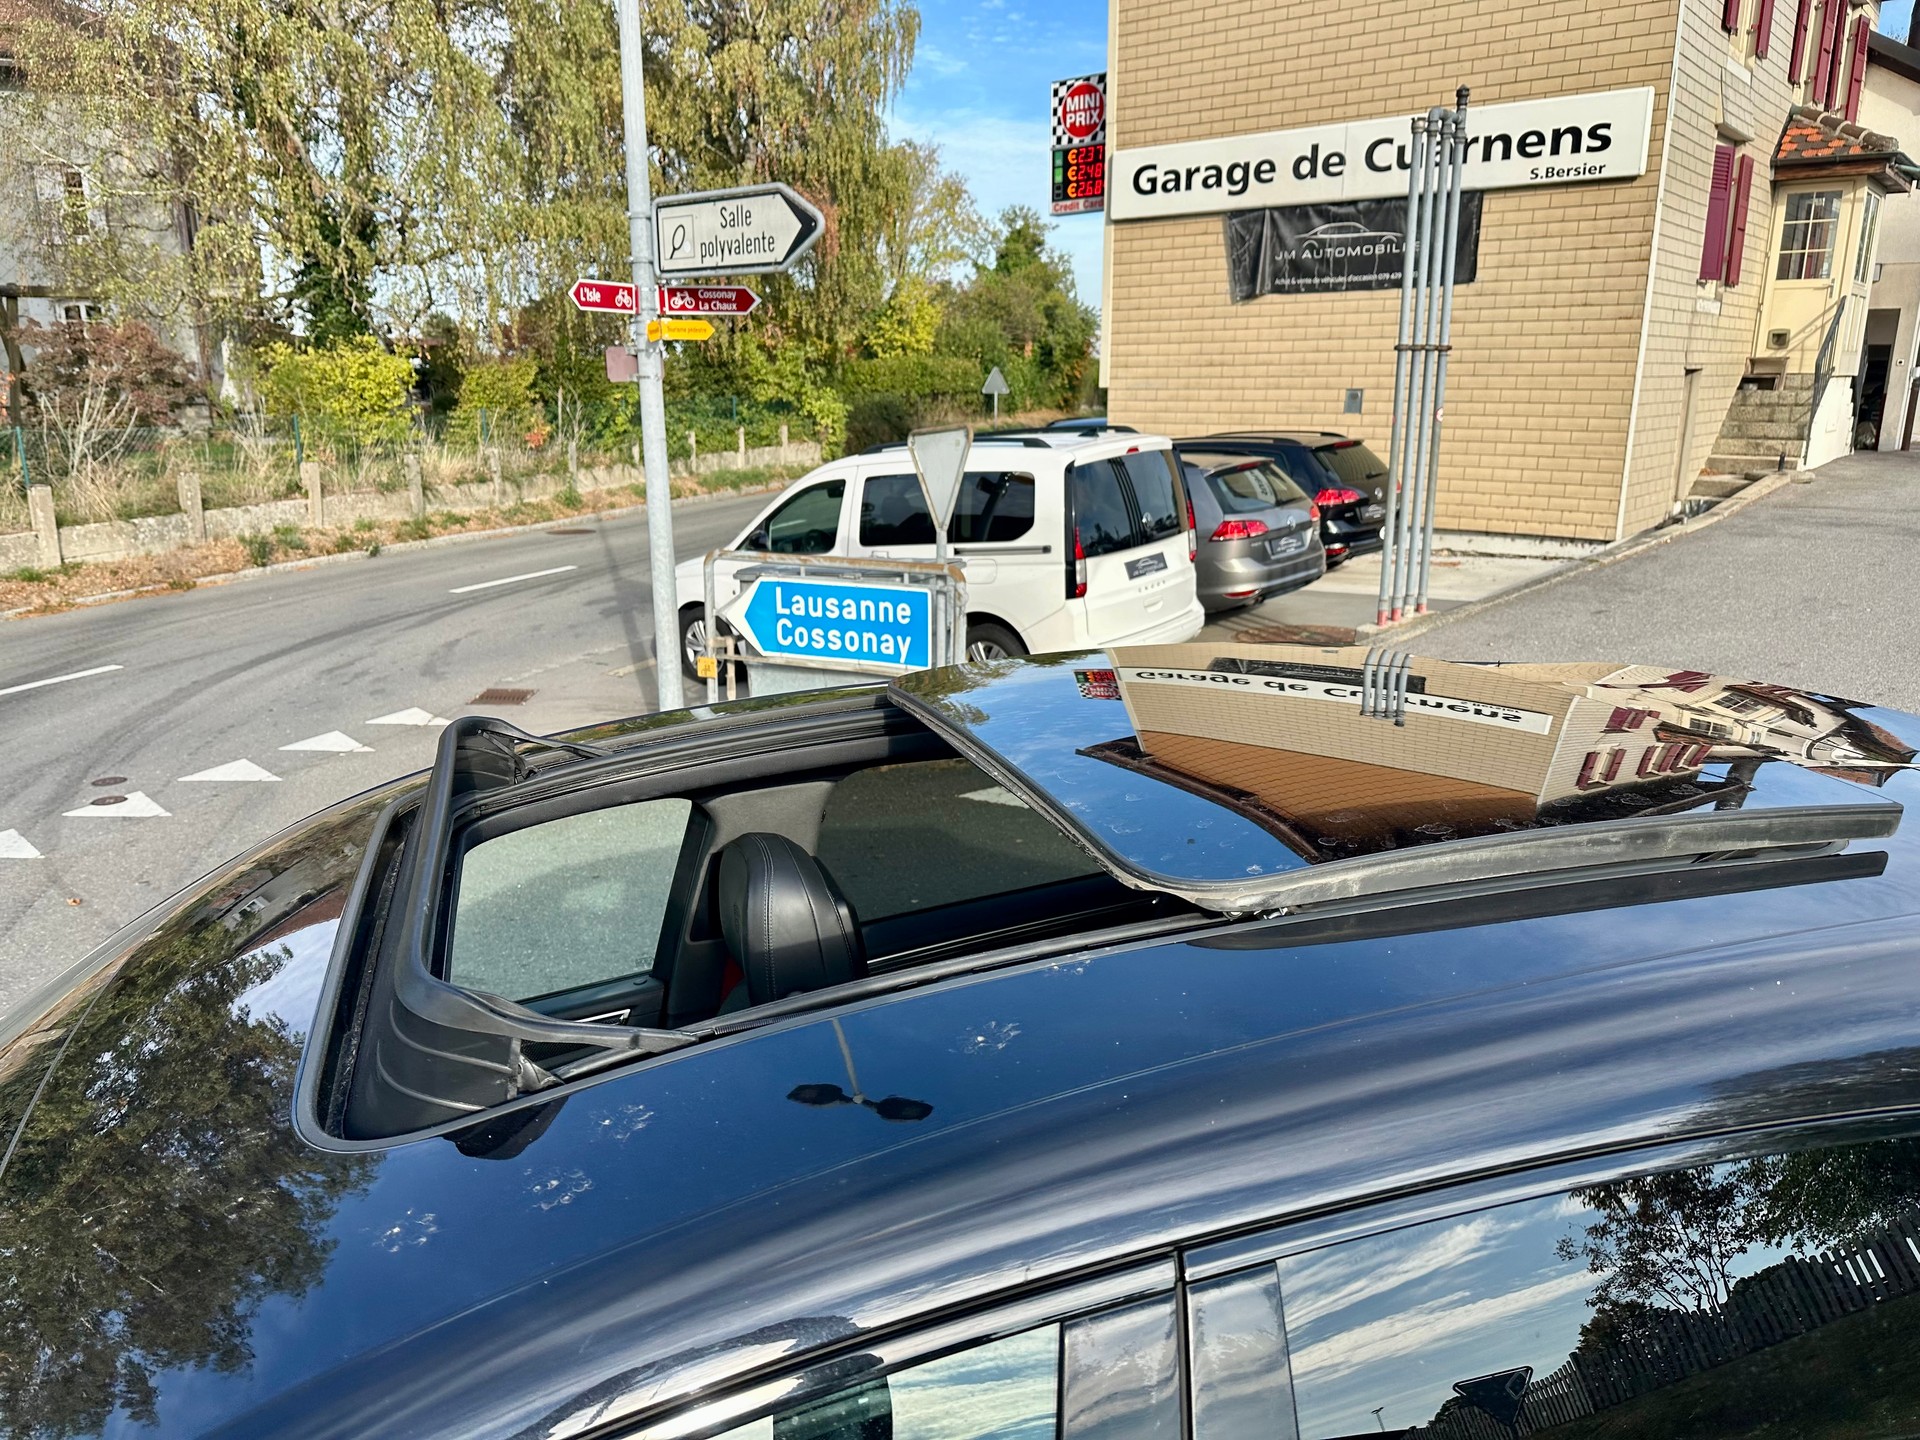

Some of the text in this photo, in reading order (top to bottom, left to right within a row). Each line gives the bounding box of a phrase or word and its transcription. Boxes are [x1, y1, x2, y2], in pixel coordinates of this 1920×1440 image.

[1066, 92, 1100, 112] MINI
[1066, 109, 1100, 128] PRIX
[1133, 158, 1276, 196] Garage
[1292, 144, 1346, 180] de
[1529, 163, 1606, 180] S.Bersier
[1053, 200, 1080, 212] Credit
[720, 204, 752, 229] Salle
[700, 231, 775, 263] polyvalente
[1275, 249, 1295, 260] JM
[580, 287, 601, 303] L'Isle
[698, 289, 736, 301] Cossonay
[699, 301, 738, 311] La Chaux
[776, 586, 911, 624] Lausanne
[776, 618, 911, 663] Cossonay
